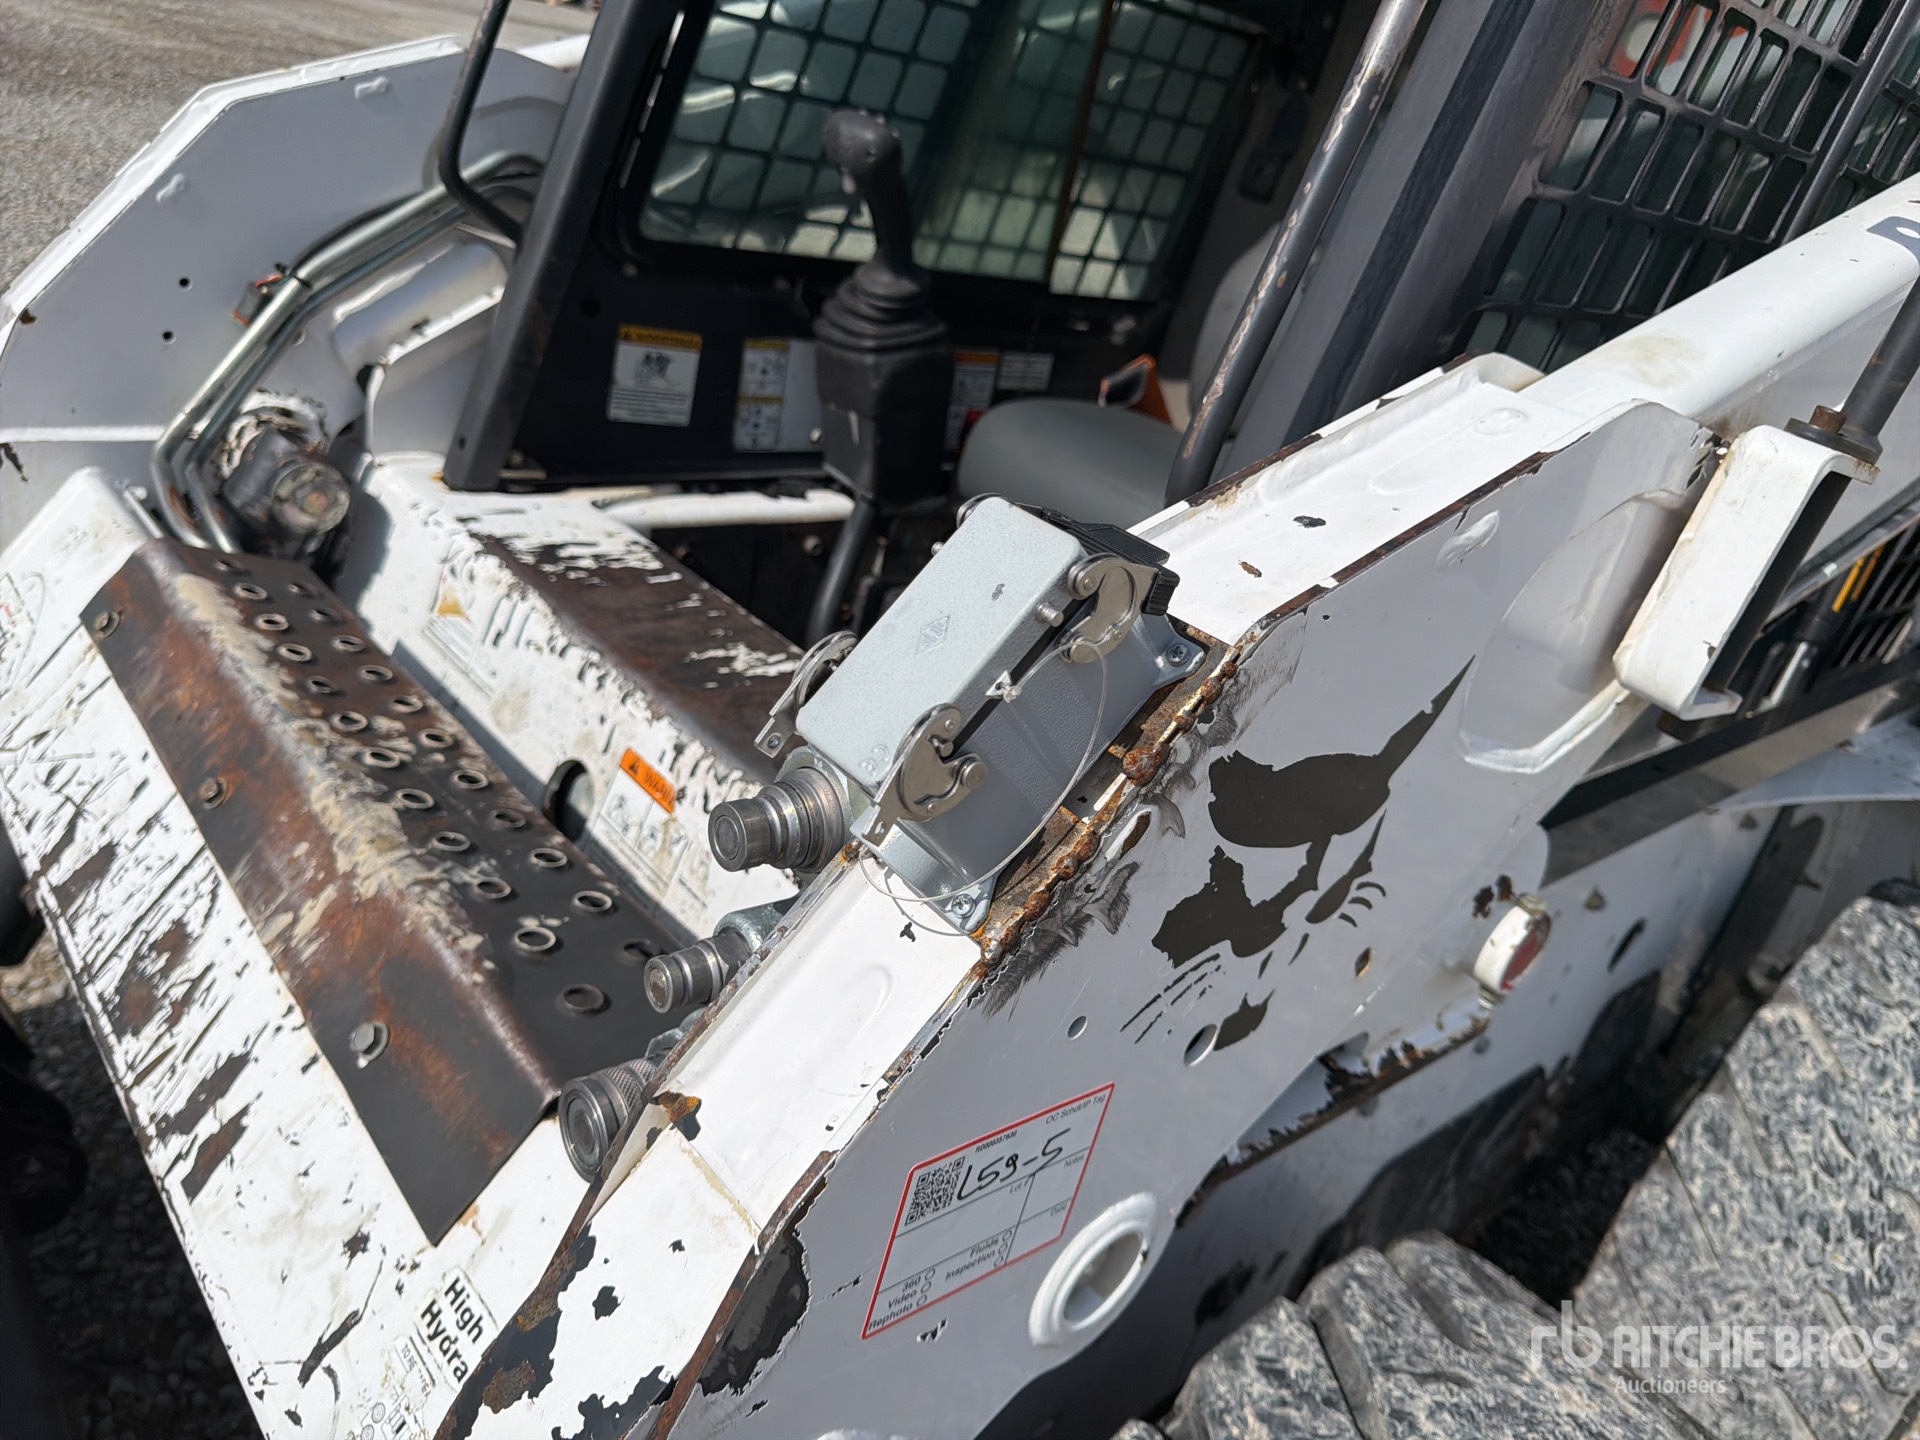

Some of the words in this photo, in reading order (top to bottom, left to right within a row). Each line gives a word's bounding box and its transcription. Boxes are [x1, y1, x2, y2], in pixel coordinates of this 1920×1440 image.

[969, 1238, 999, 1258] Fluids
[945, 1250, 996, 1281] Inspection
[902, 1277, 921, 1292] 360
[444, 1276, 485, 1344] High
[888, 1290, 917, 1310] Video
[868, 1303, 913, 1331] Rephoto
[421, 1298, 469, 1384] Hydra
